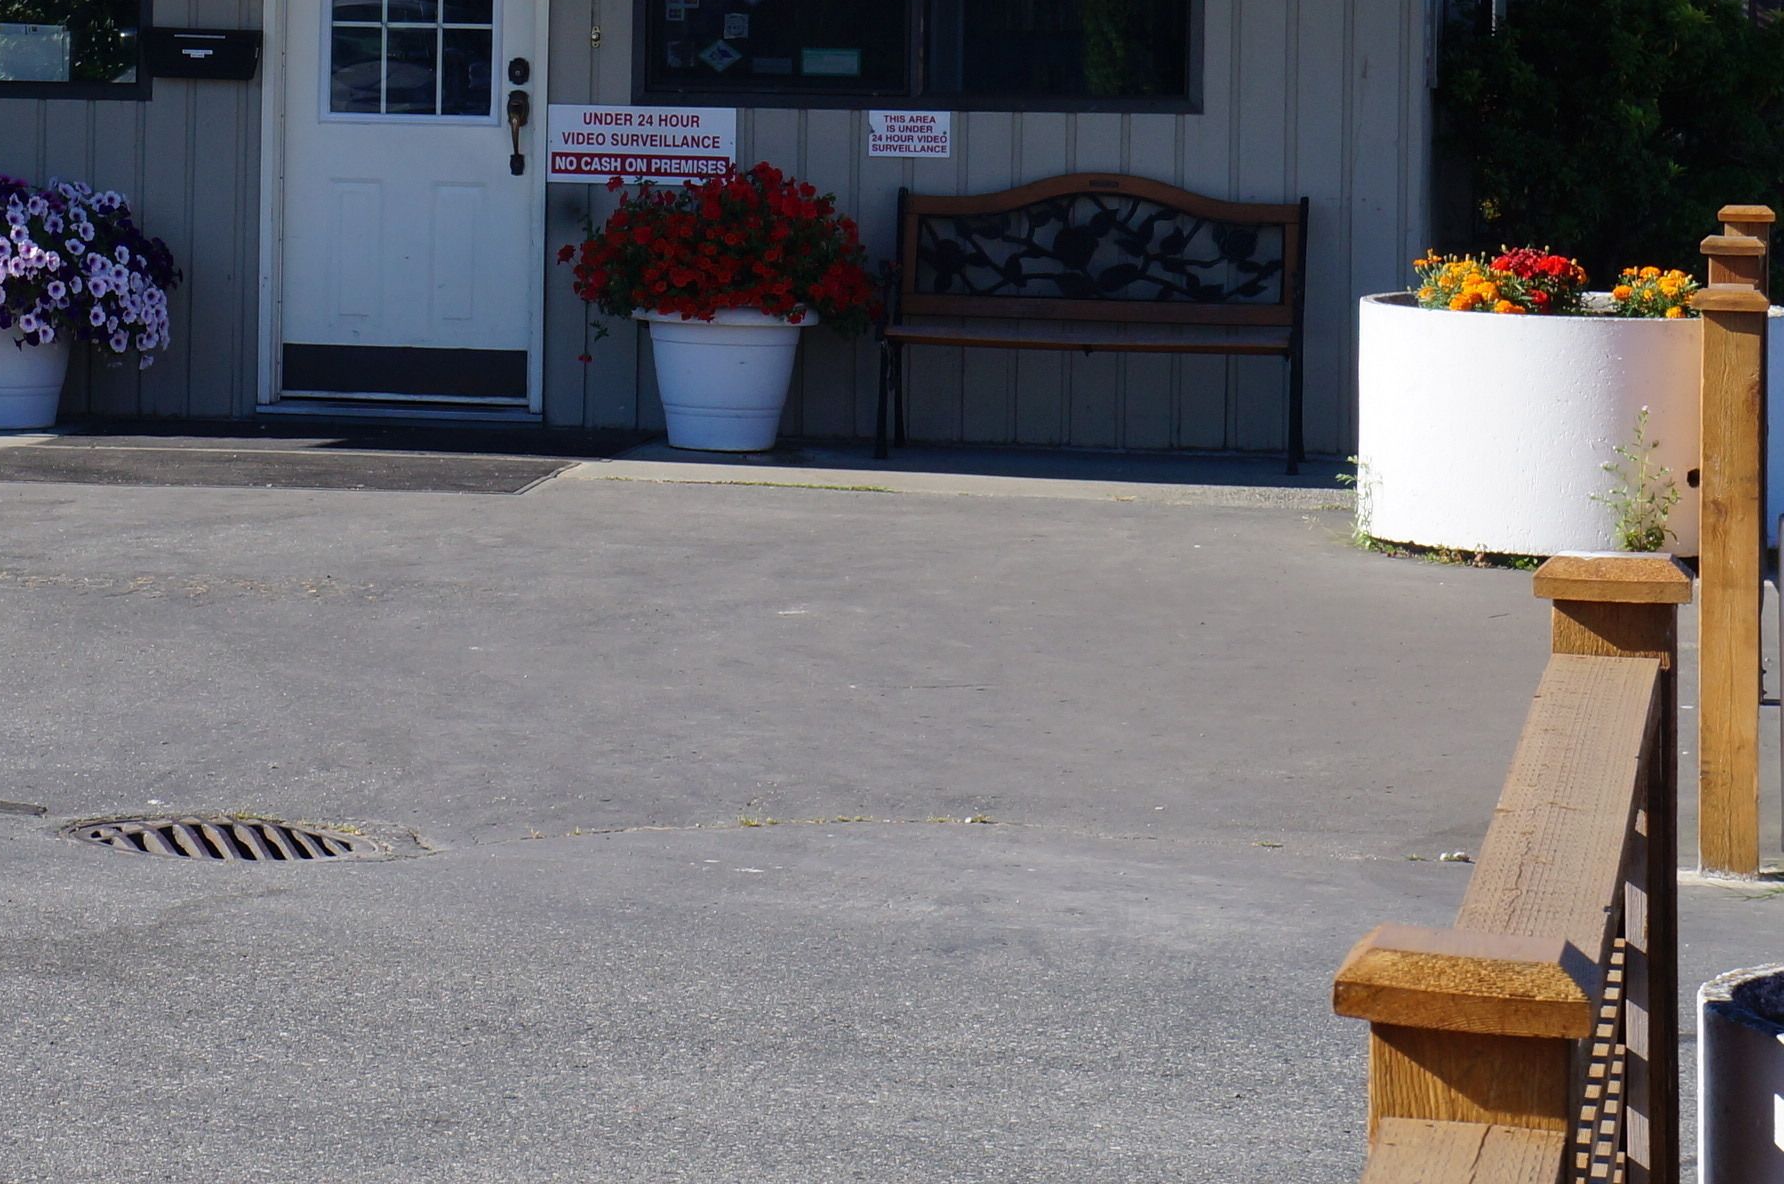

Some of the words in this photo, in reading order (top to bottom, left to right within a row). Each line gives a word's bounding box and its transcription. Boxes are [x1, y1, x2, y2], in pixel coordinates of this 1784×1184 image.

[583, 113, 633, 126] UNDER
[638, 114, 654, 127] 24
[659, 114, 700, 129] HOUR
[884, 115, 906, 123] THIS
[909, 115, 936, 124] AREA
[886, 124, 895, 133] IS
[899, 124, 933, 133] UNDER
[562, 132, 605, 146] VIDEO
[611, 132, 721, 149] SURVEILLANCE
[871, 134, 883, 143] 24
[885, 134, 914, 143] HOUR
[917, 134, 948, 144] VIDEO
[871, 143, 947, 153] SURVEILLANCE
[555, 155, 577, 171] NO
[580, 156, 622, 172] CASH
[625, 157, 647, 173] ON
[651, 158, 727, 176] PREMISES
